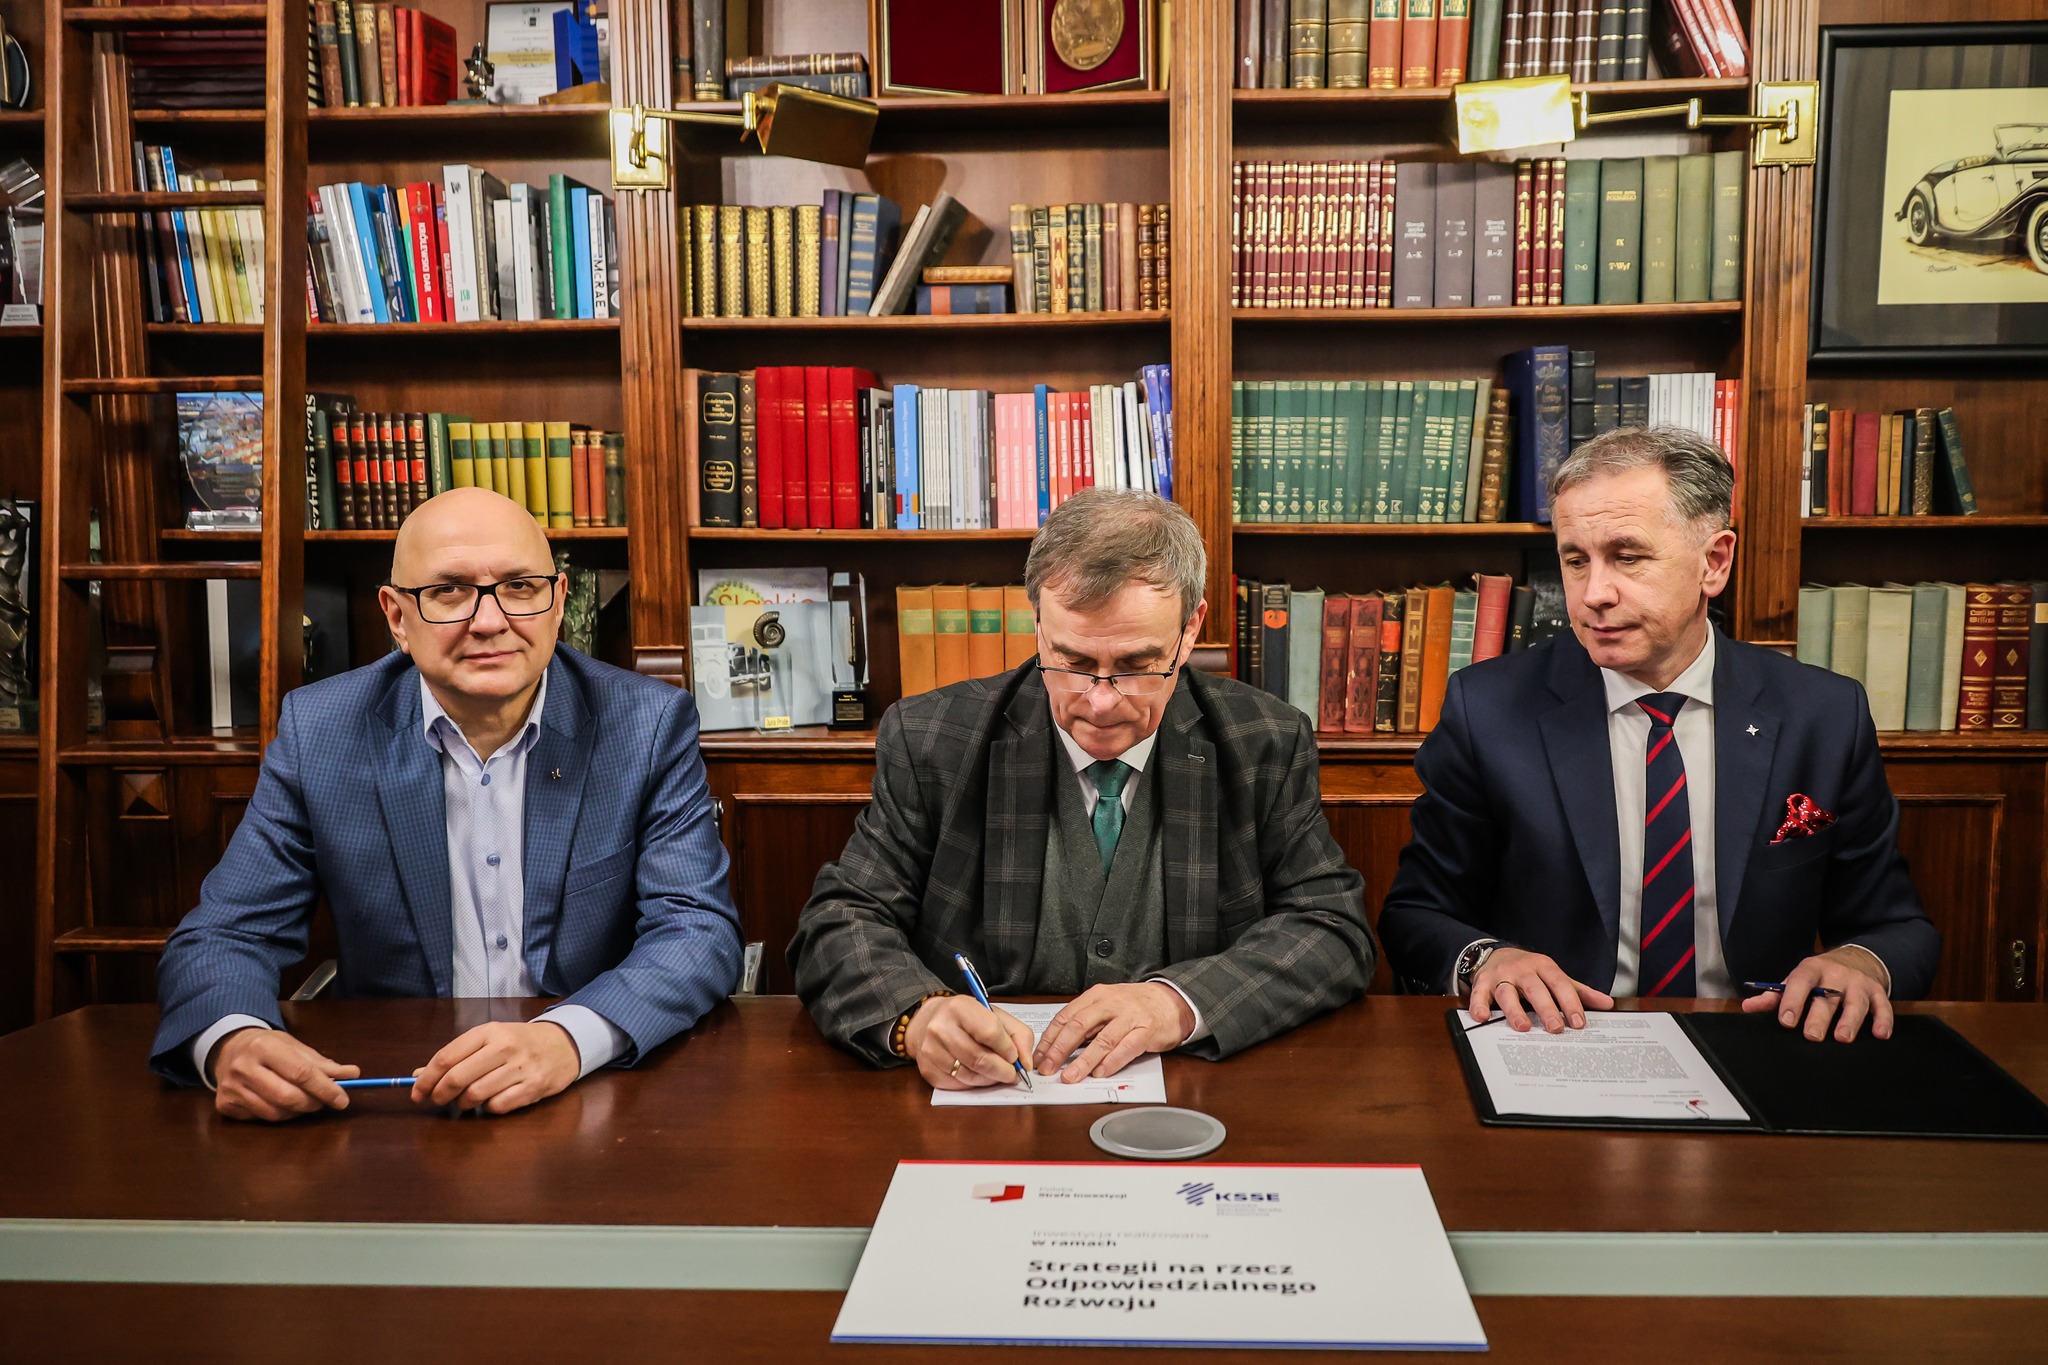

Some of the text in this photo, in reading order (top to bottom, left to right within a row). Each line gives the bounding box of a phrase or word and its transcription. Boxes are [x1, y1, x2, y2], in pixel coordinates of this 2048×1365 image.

[1405, 251, 1423, 259] A-K
[422, 273, 432, 293] DAR
[593, 259, 606, 308] McRAE
[1215, 1192, 1281, 1202] KSSE
[1032, 1230, 1210, 1240] Inwestycja realizowana
[1050, 1238, 1118, 1248] ramach
[1028, 1260, 1294, 1275] Strategii na rzecz
[1025, 1277, 1317, 1295] Odpowiedzialnego
[1023, 1295, 1156, 1313] Rozwoju
